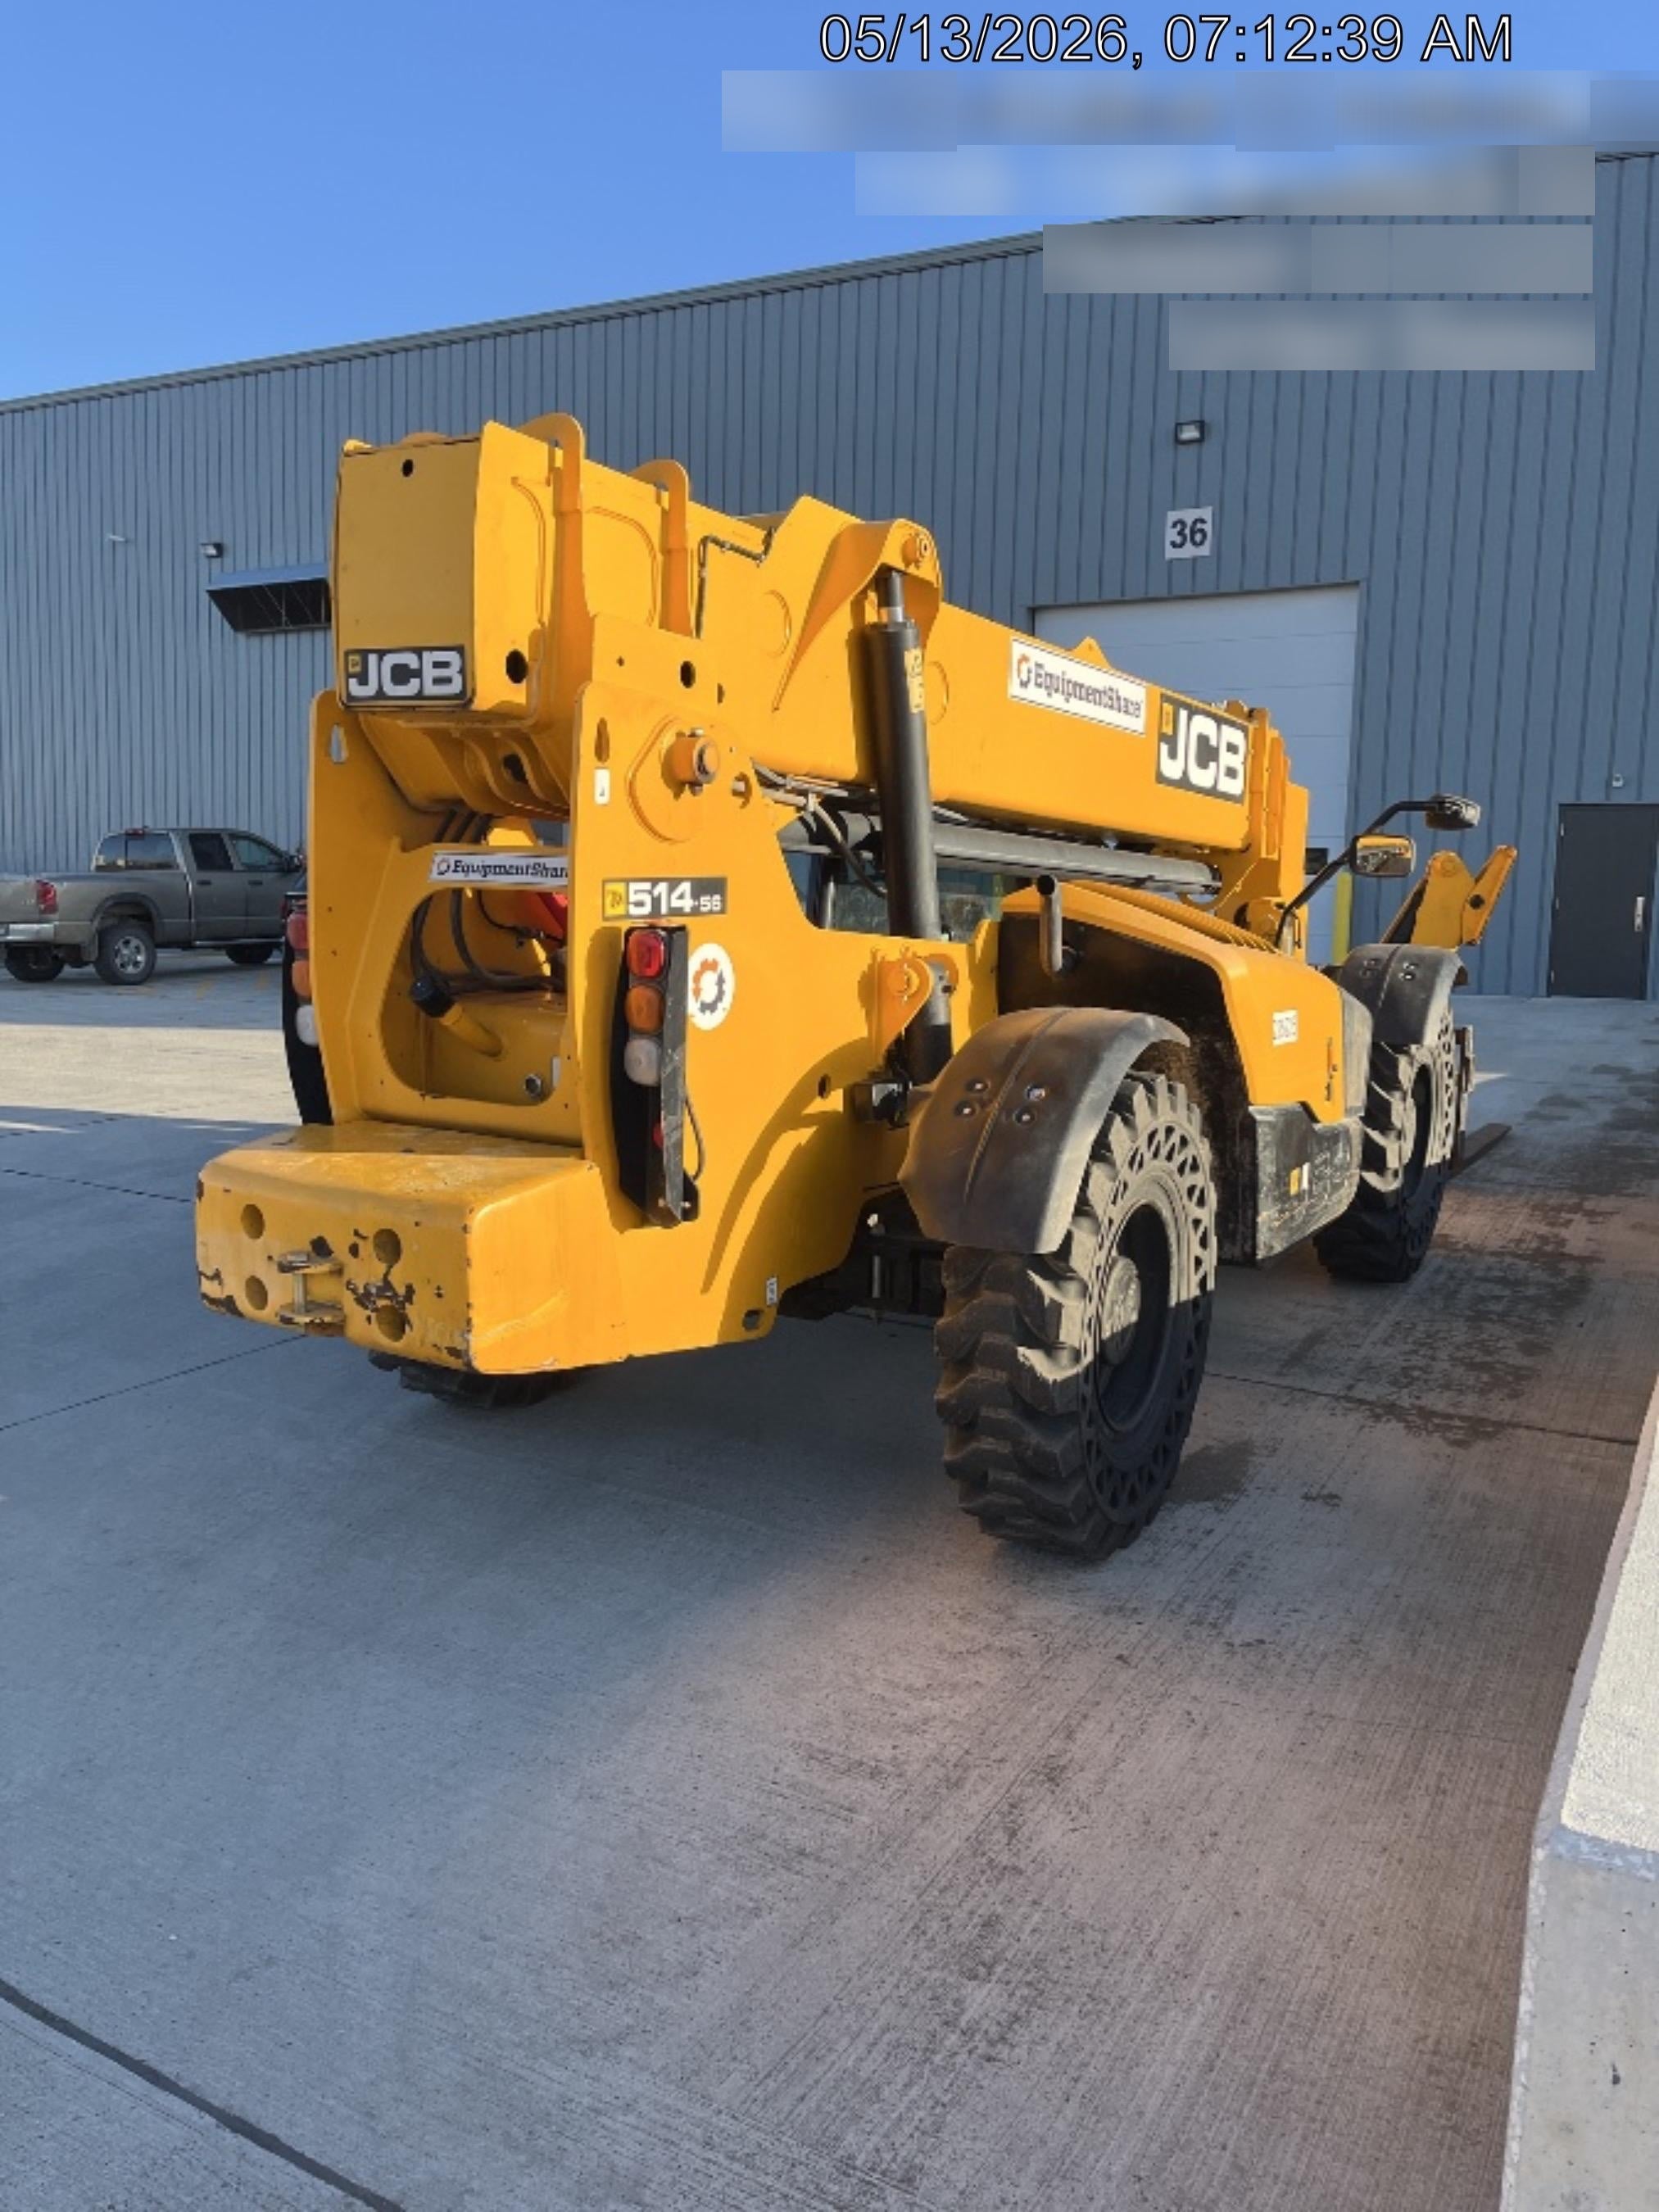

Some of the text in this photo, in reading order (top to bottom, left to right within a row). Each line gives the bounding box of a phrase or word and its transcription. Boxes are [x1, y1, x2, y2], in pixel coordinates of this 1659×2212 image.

[1170, 517, 1208, 549] 36
[348, 650, 463, 697] JCB
[1034, 660, 1141, 718] EquipmentShare
[1159, 707, 1246, 796] JCB
[451, 859, 569, 878] EquipmentShar
